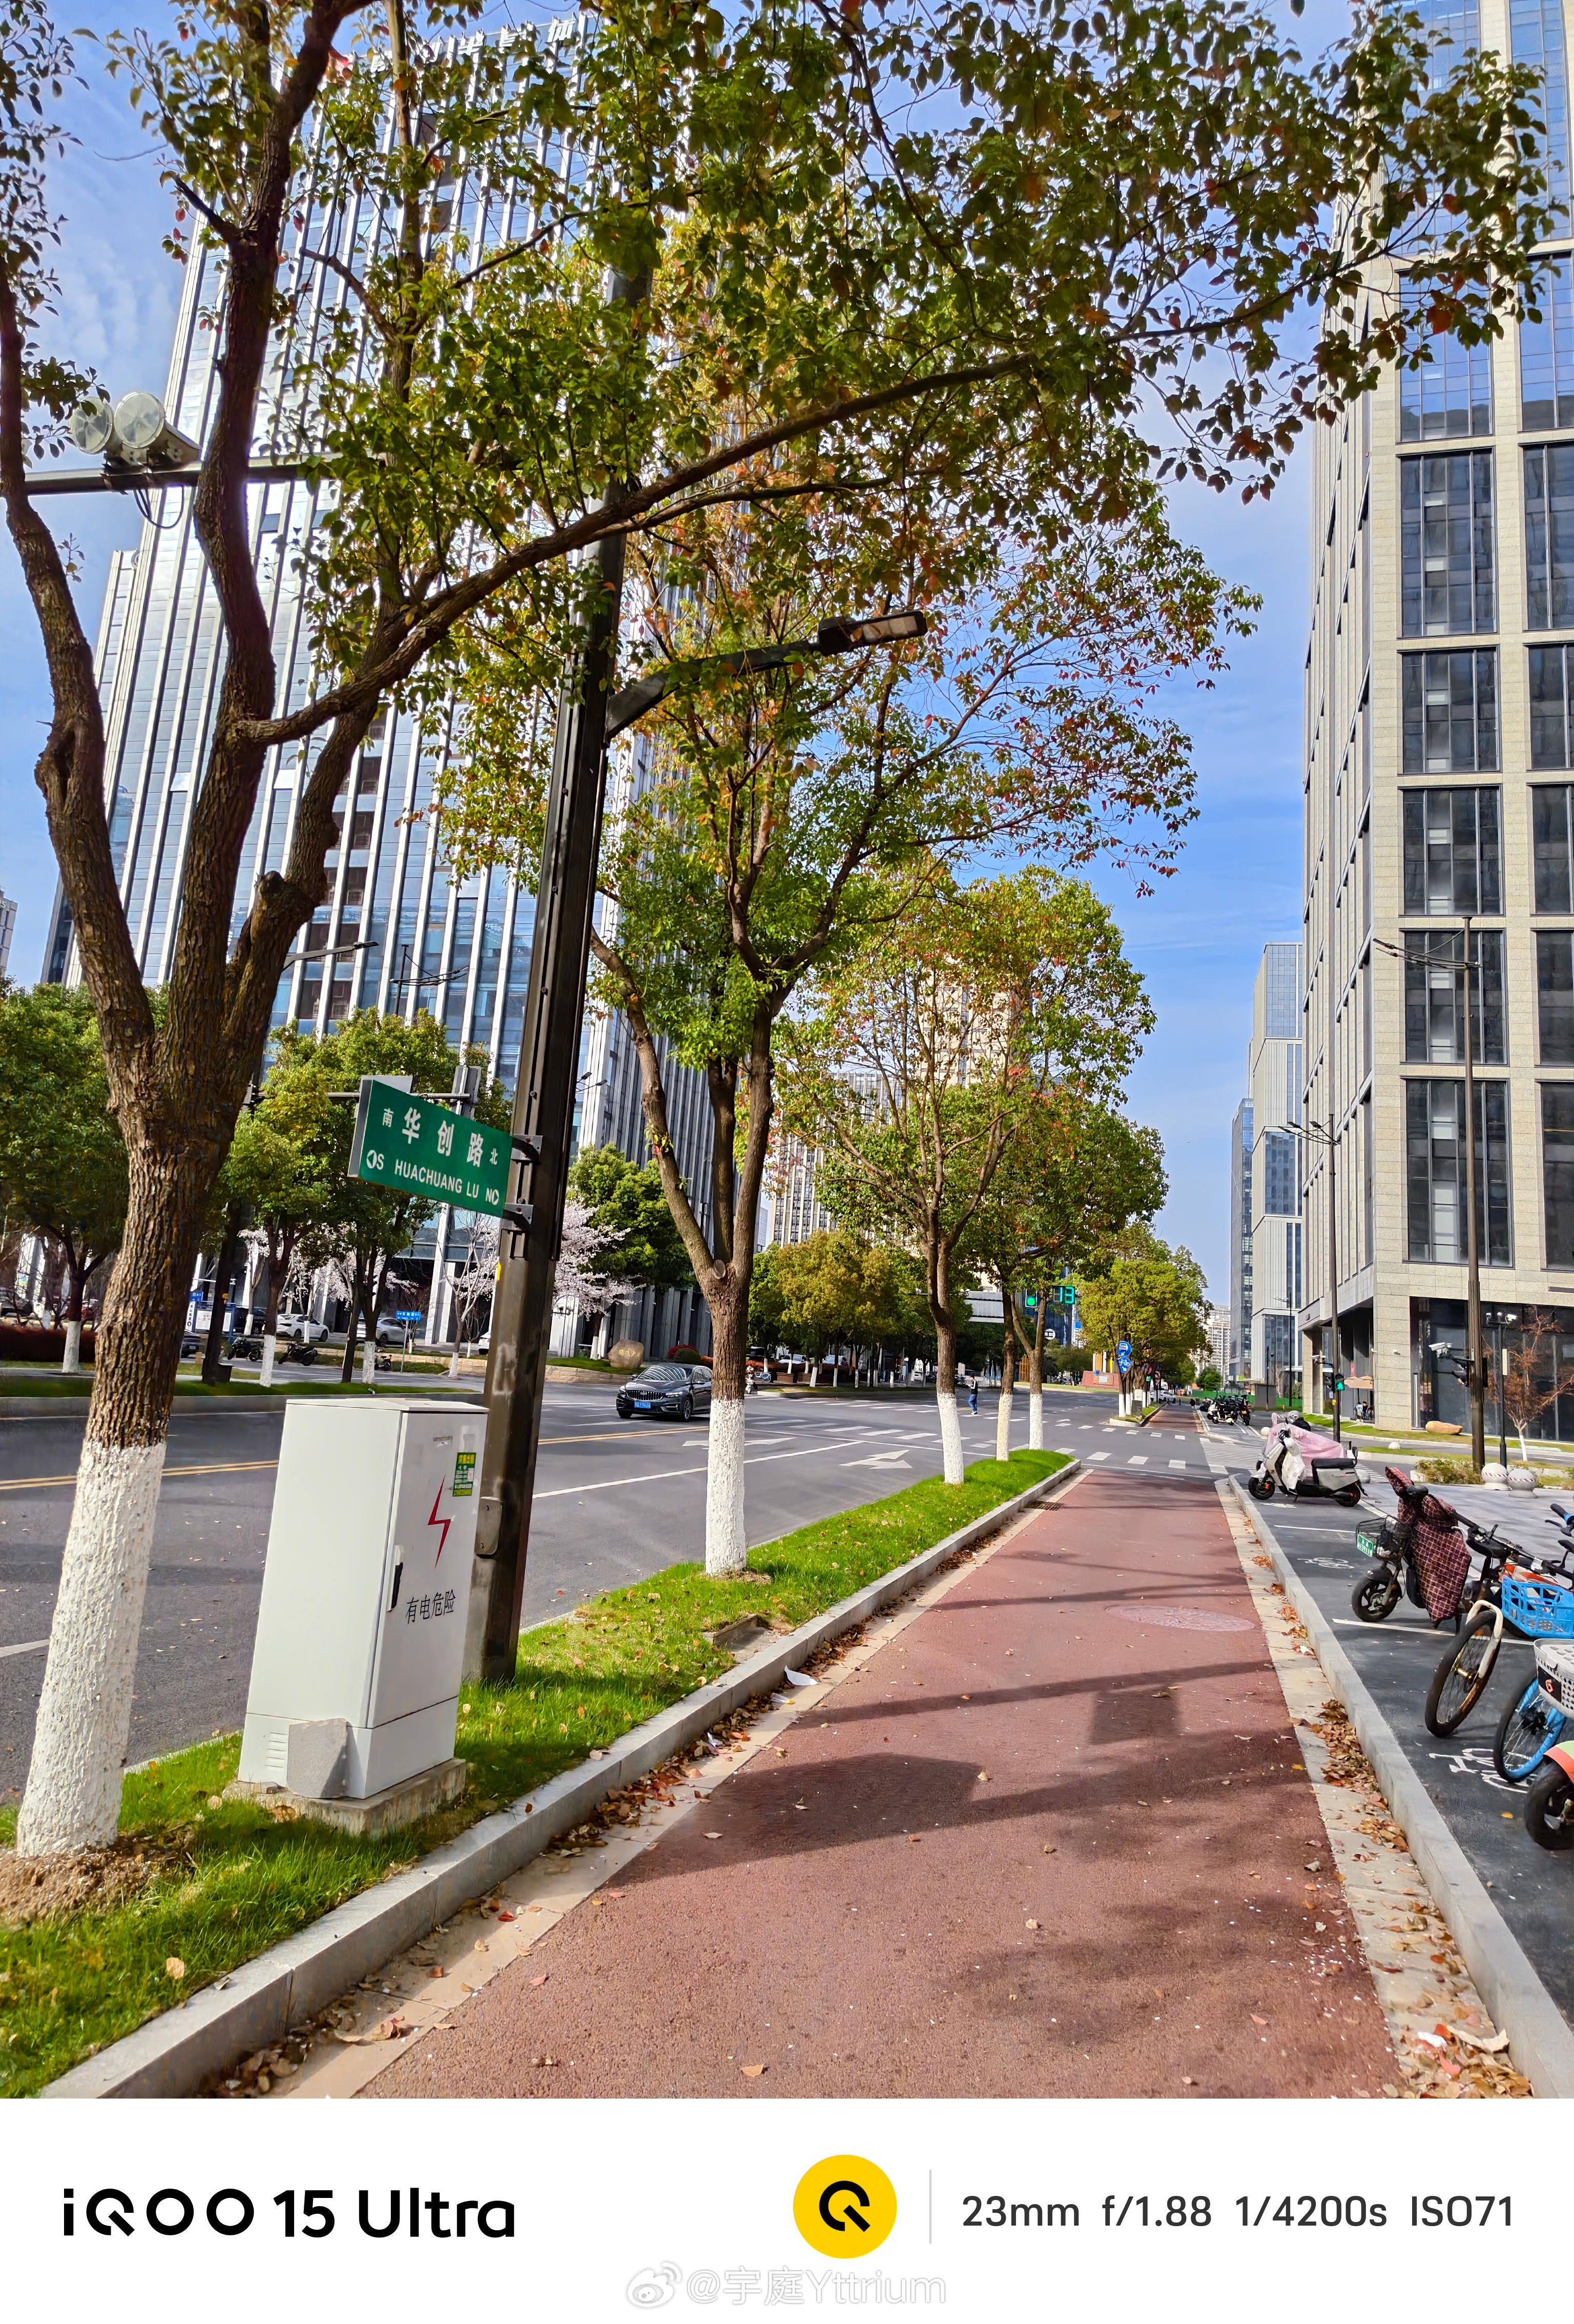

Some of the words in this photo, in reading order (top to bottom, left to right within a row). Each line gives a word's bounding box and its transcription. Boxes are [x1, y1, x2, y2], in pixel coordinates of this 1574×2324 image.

[382, 1108, 394, 1128] 南
[402, 1107, 483, 1168] 华创路
[489, 1148, 498, 1166] 北
[376, 1155, 384, 1170] S
[395, 1159, 462, 1194] HUACHUANG
[467, 1181, 479, 1198] LU
[1059, 1287, 1074, 1303] 13
[405, 1589, 456, 1625] 有电危险
